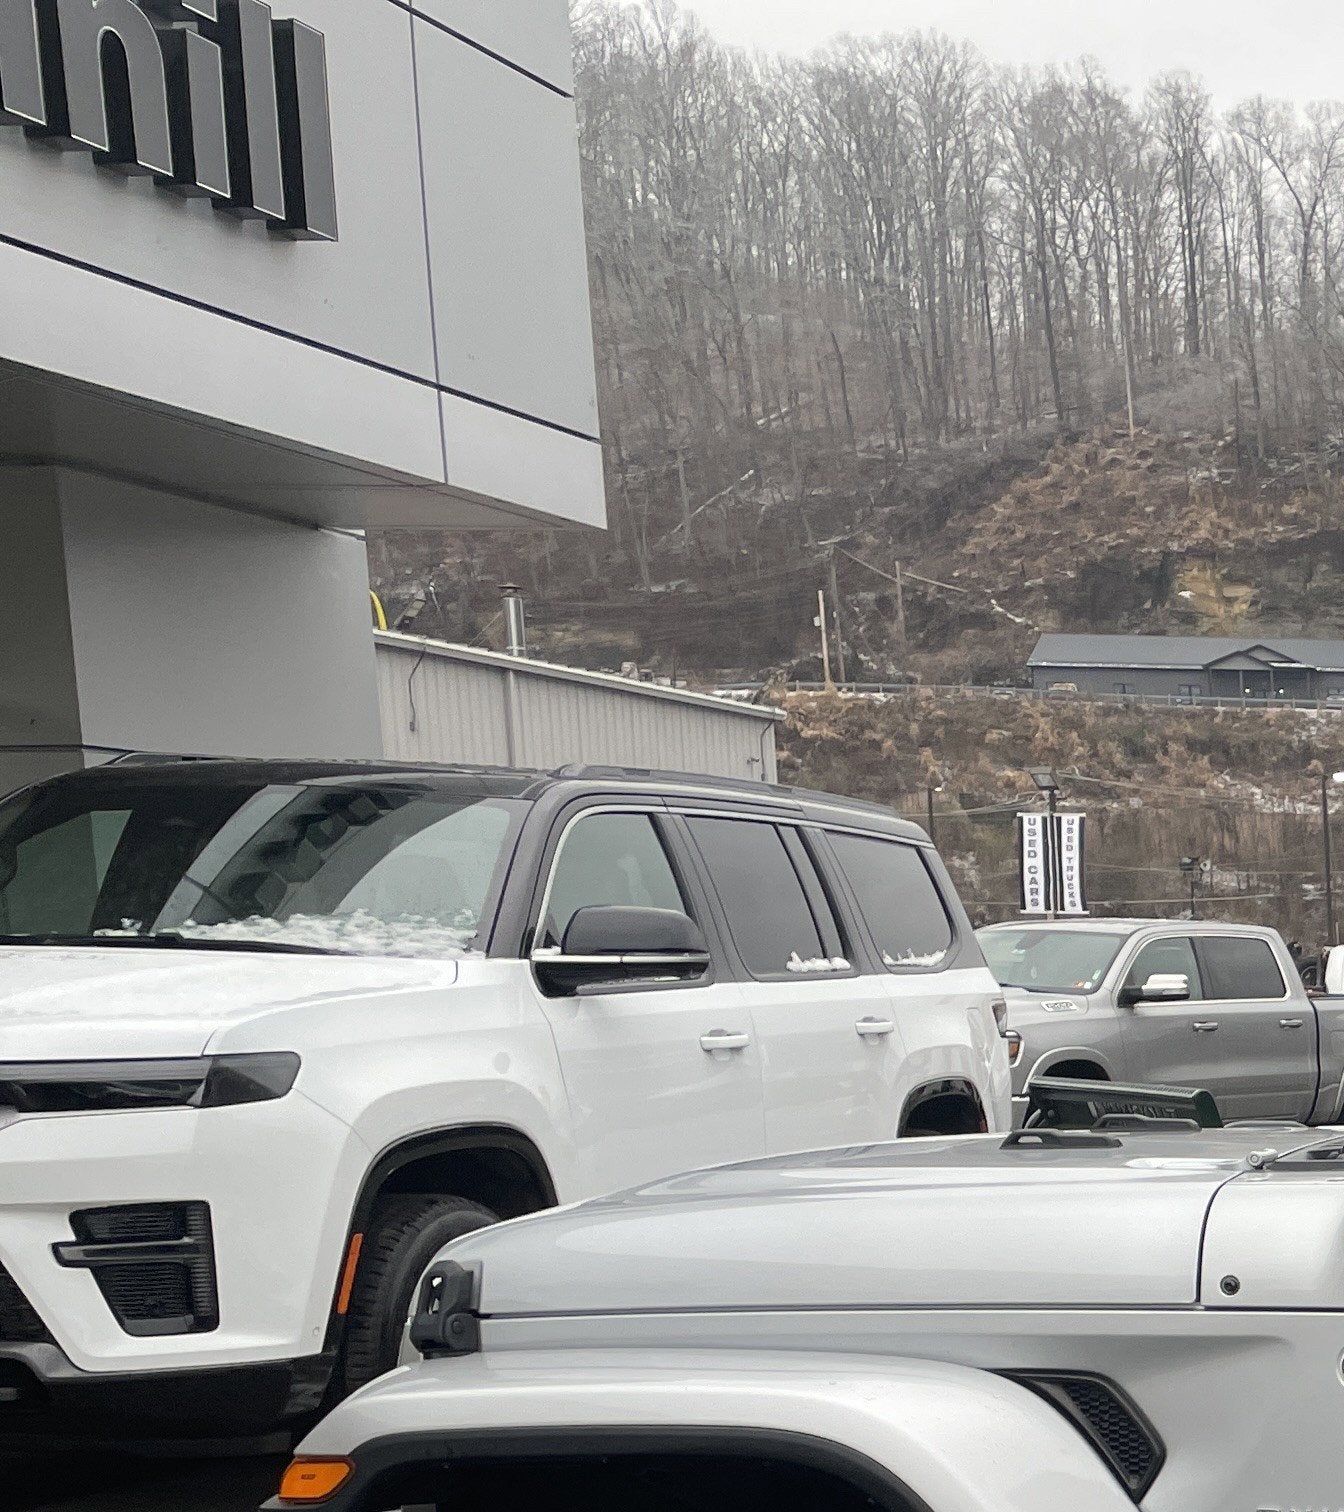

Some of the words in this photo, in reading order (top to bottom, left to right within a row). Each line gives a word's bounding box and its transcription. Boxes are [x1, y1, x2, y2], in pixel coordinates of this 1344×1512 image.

[1027, 817, 1038, 859] USED
[1065, 818, 1075, 852] USED
[1028, 865, 1039, 907] CARS
[1065, 856, 1077, 908] TRUCKS
